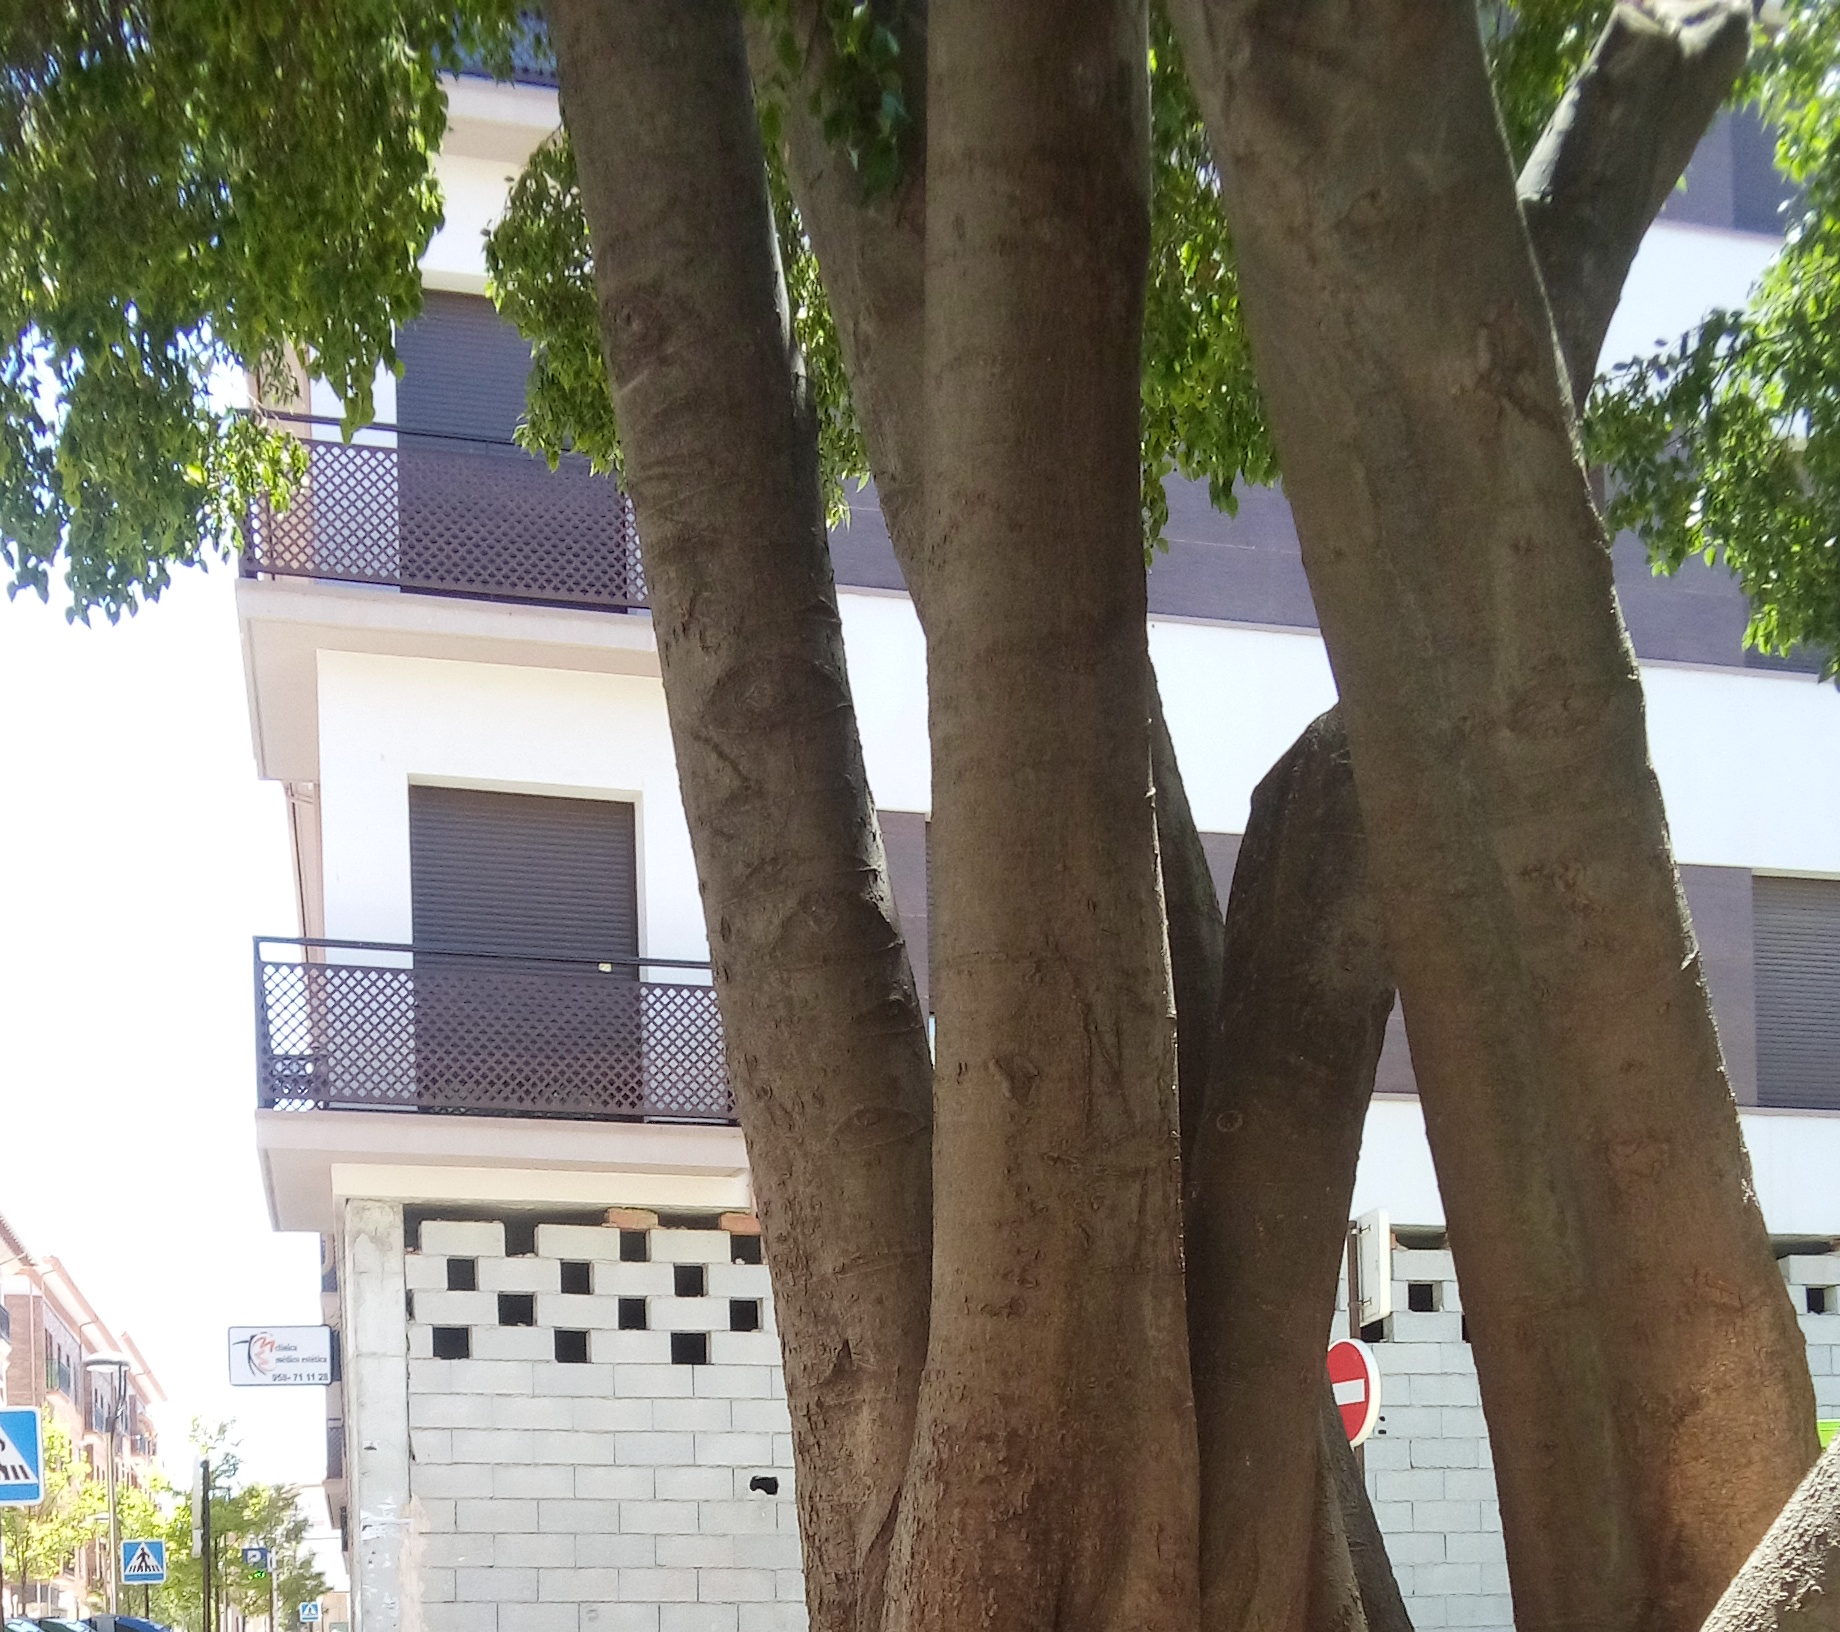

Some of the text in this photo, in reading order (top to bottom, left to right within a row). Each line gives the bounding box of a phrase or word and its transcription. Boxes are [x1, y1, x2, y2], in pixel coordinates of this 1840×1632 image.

[293, 1373, 303, 1381] 71
[306, 1373, 315, 1381] 11
[247, 1550, 262, 1567] P
